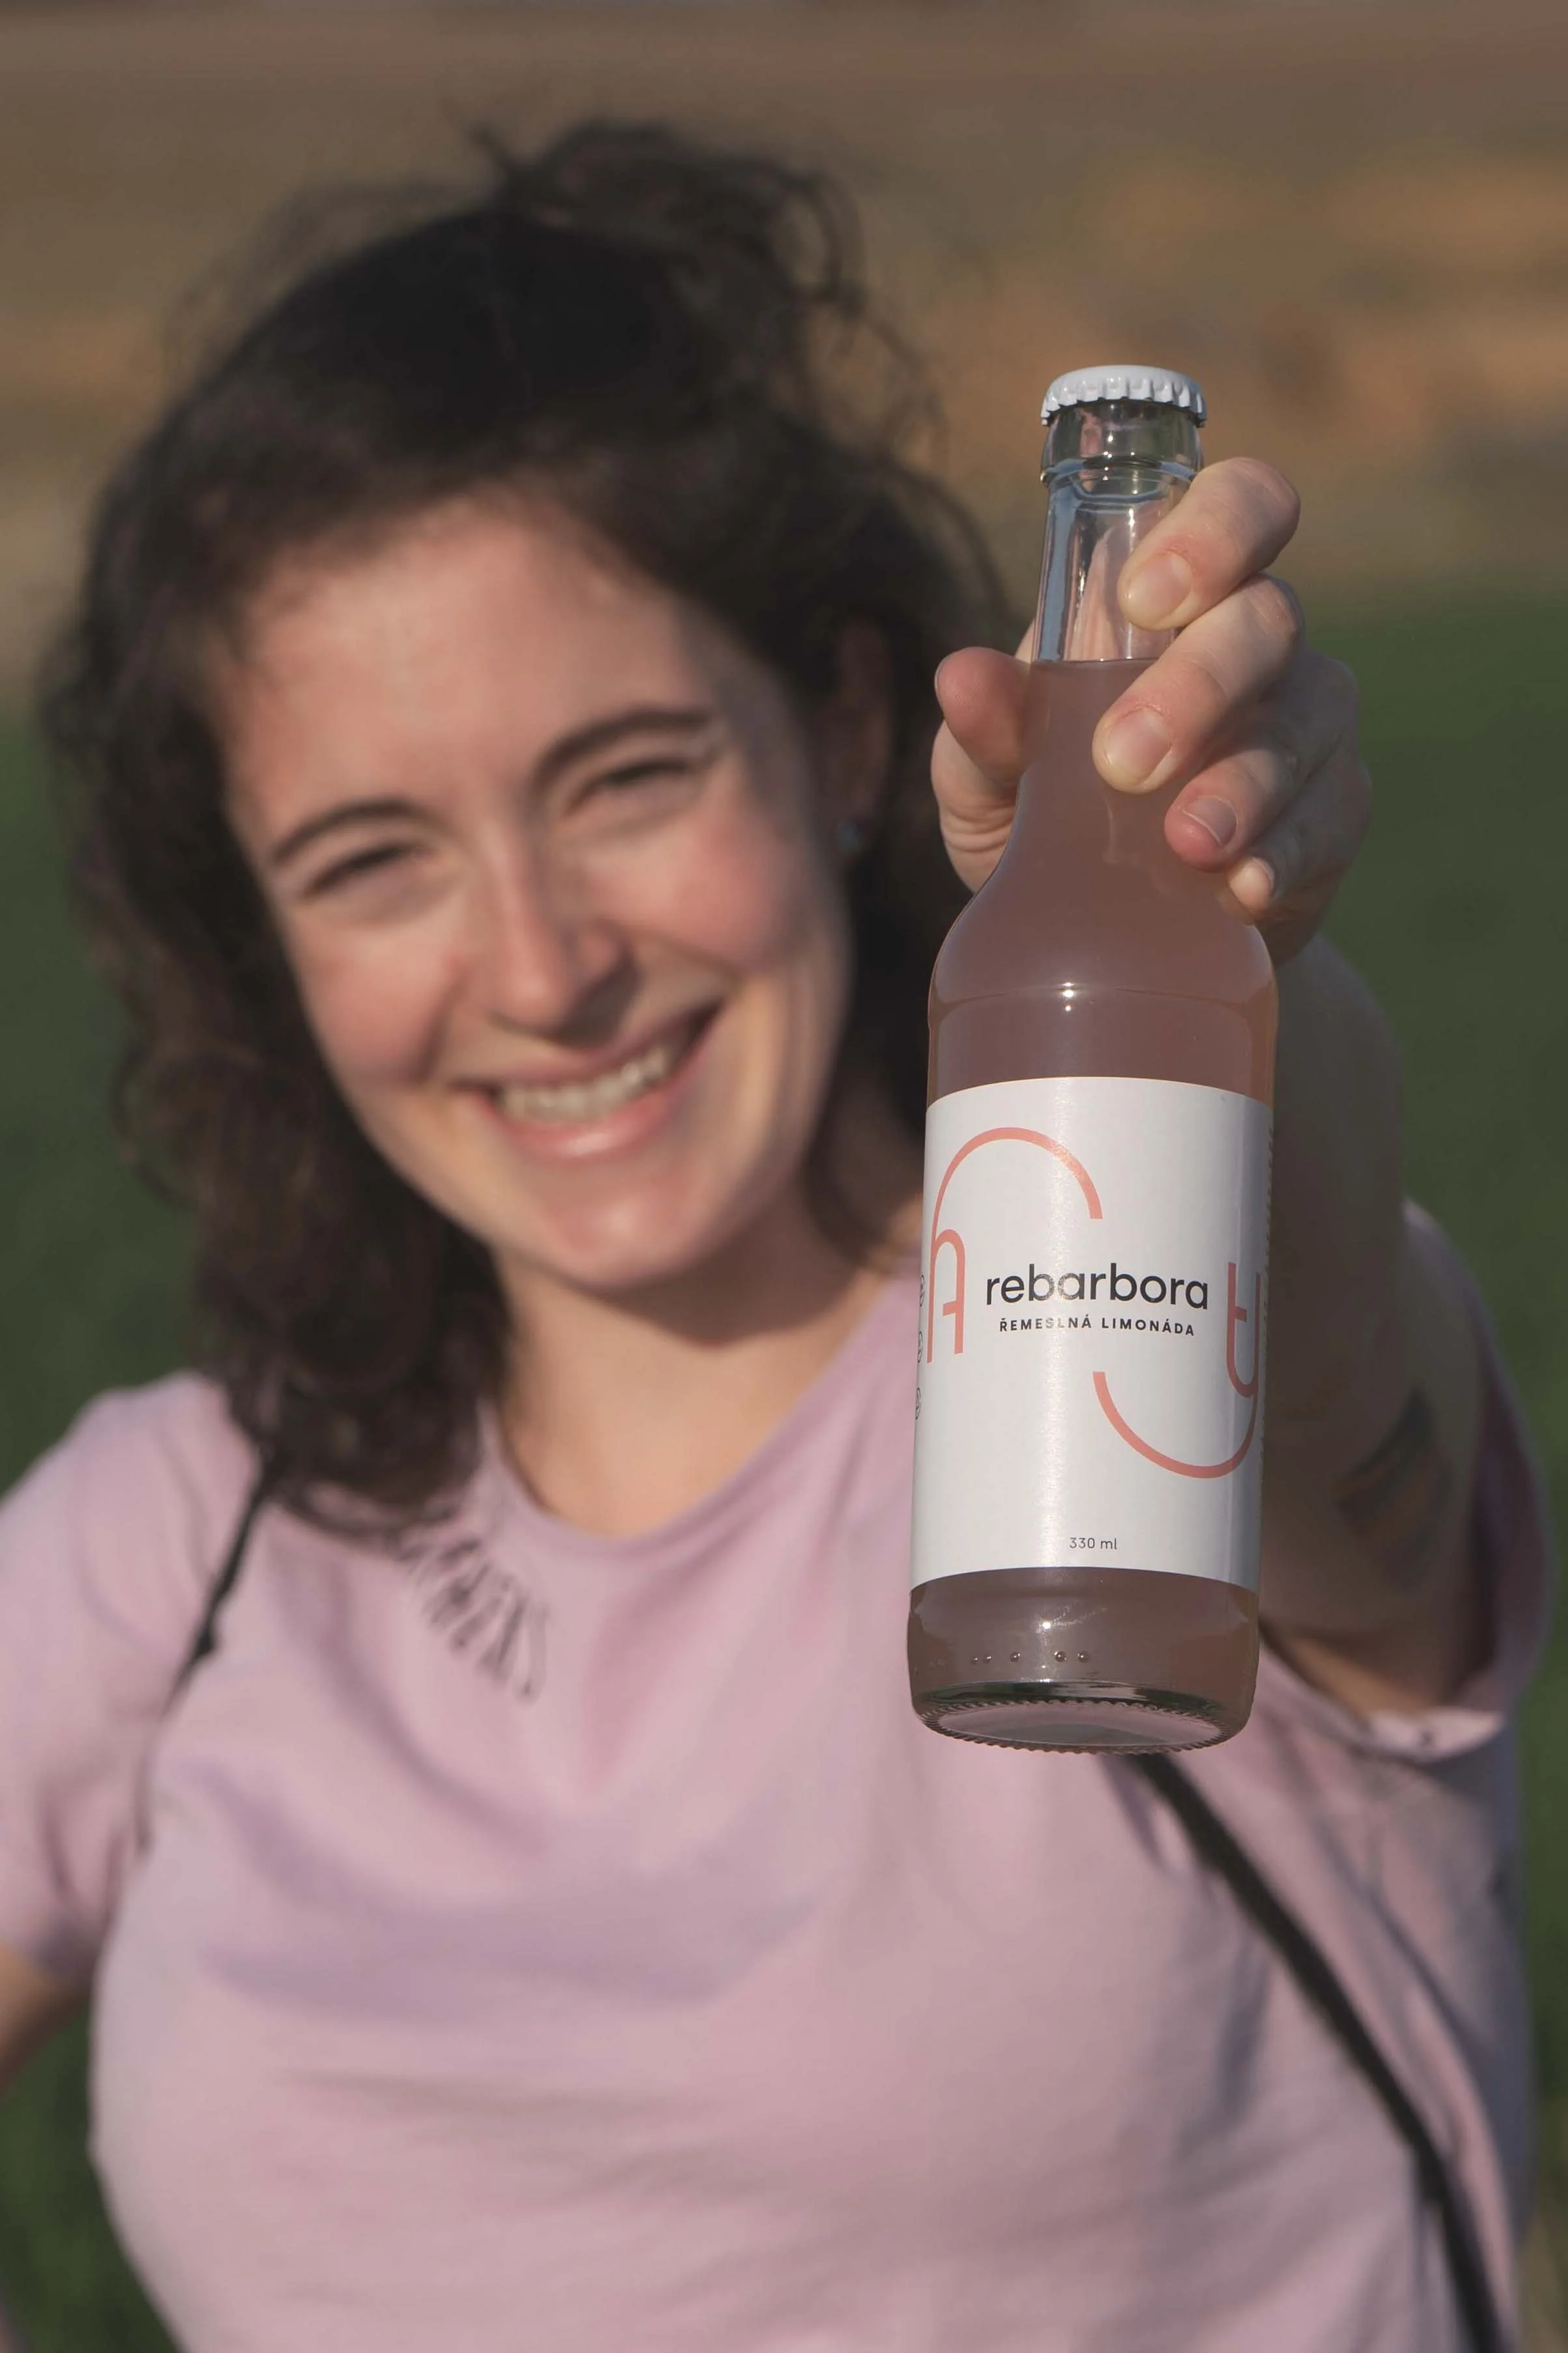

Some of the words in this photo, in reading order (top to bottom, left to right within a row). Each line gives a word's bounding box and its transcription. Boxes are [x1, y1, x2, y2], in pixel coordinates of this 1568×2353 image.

[986, 1262, 1208, 1310] rebarbora
[999, 1314, 1092, 1332] ŘEMESLNÁ
[1102, 1318, 1195, 1336] LIMONÁDA
[1069, 1537, 1095, 1549] 330
[1100, 1538, 1118, 1549] ml
